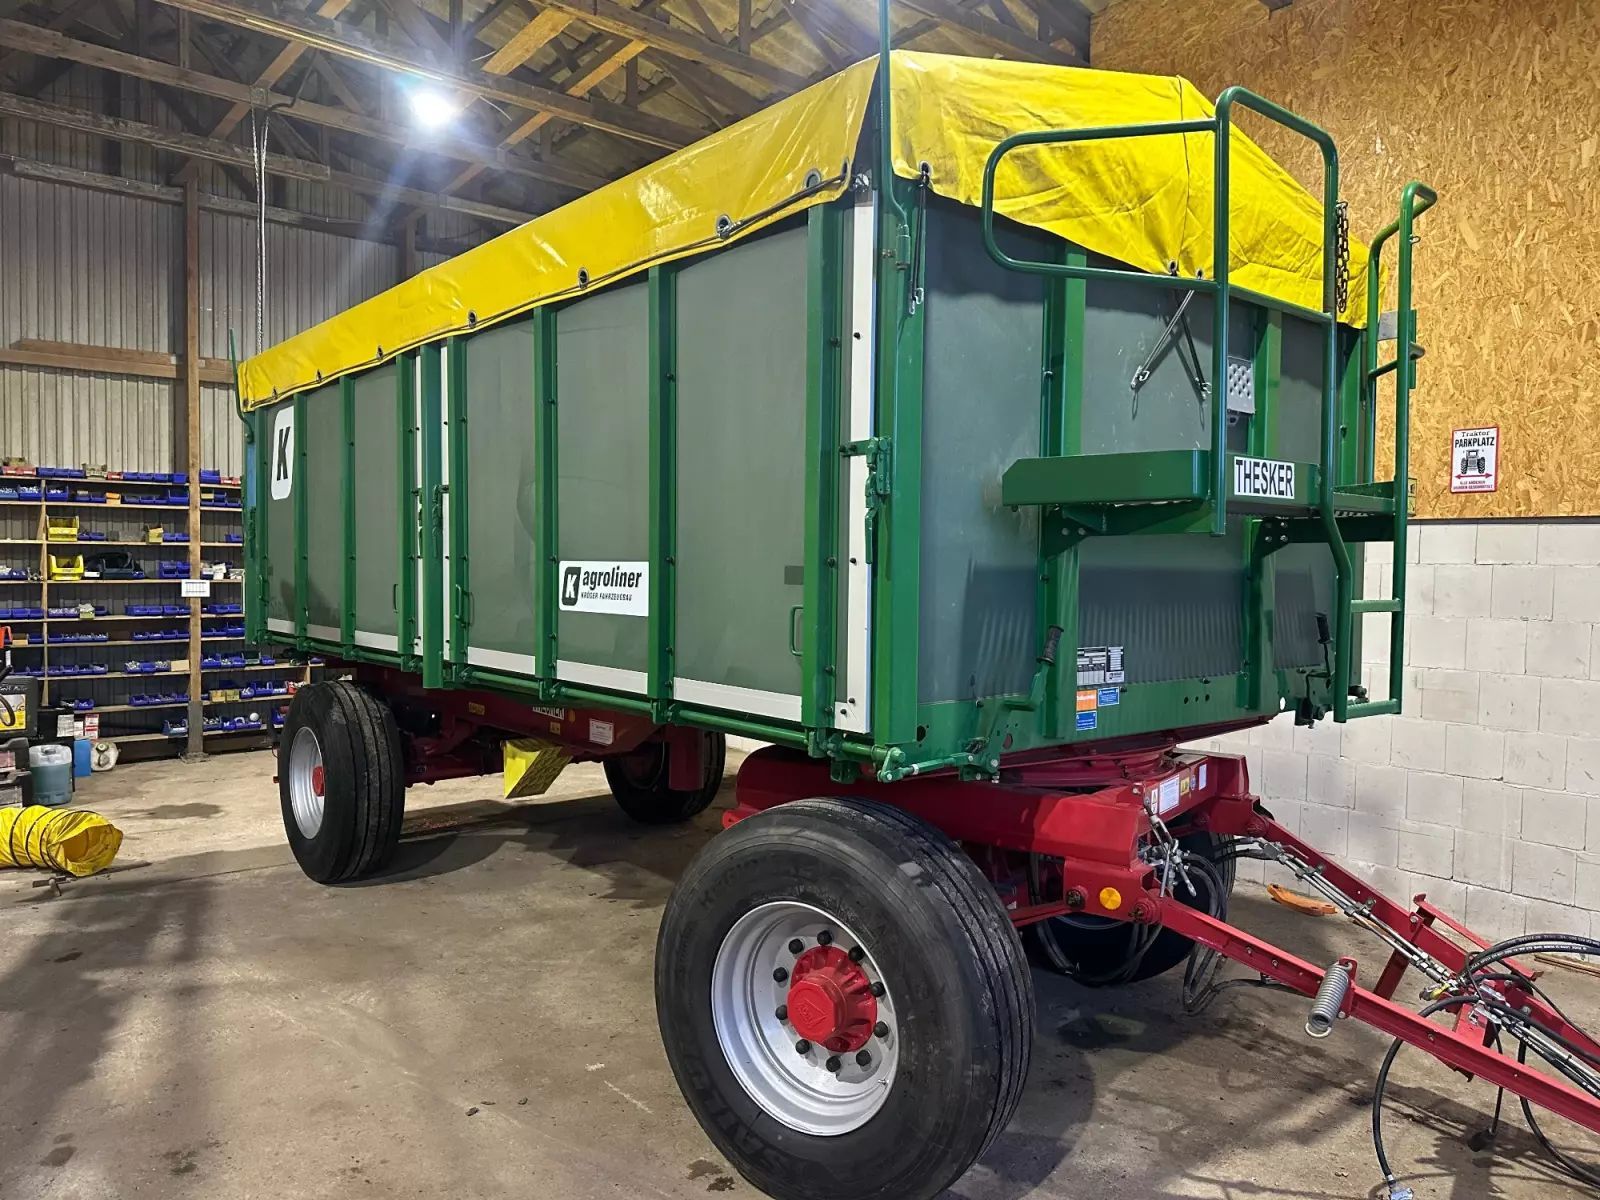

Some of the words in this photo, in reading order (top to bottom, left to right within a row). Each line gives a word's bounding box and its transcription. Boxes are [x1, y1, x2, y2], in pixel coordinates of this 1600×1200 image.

[276, 426, 291, 481] K
[1455, 437, 1495, 448] PARKPLATZ
[1236, 460, 1293, 496] THESKER
[565, 574, 577, 598] K
[582, 565, 642, 591] agroliner
